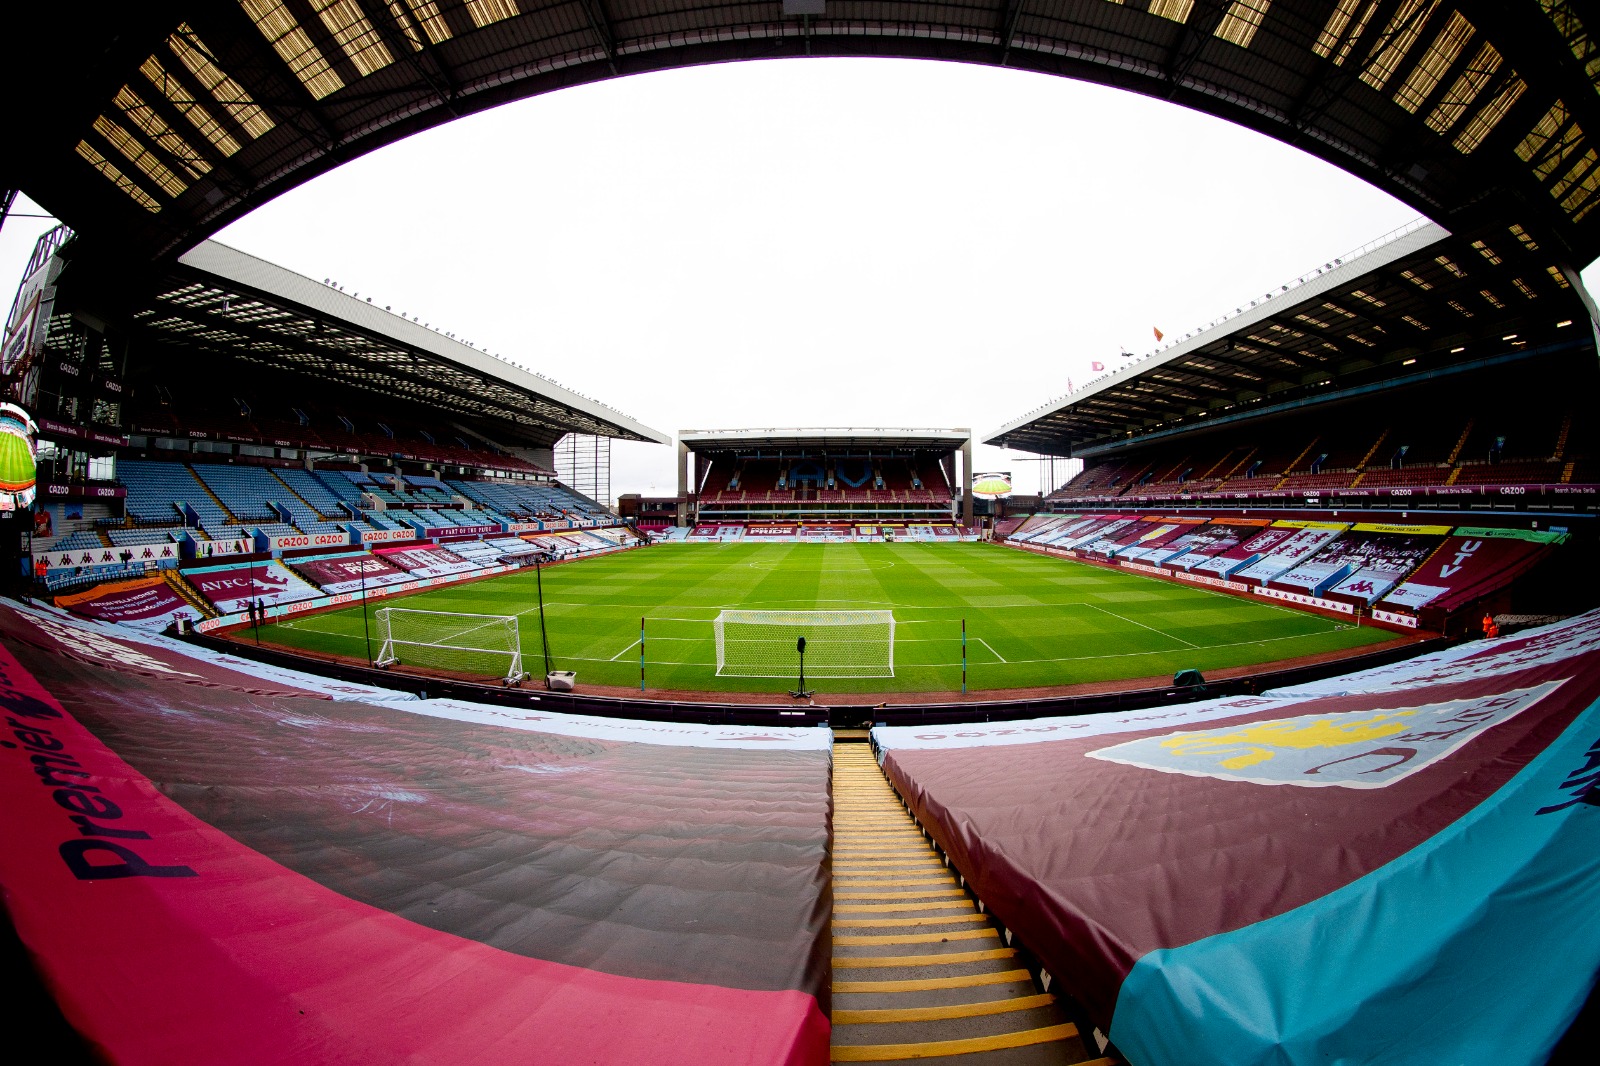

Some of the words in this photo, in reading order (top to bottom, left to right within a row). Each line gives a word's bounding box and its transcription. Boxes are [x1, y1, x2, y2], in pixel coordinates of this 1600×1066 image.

[60, 362, 79, 377] CAZOO
[105, 380, 122, 393] CAZOO
[49, 485, 69, 495] CAZOO
[98, 488, 115, 496] CAZOO
[277, 537, 309, 548] CAZOO
[315, 535, 343, 544] CAZOO
[364, 532, 388, 541] CAZOO
[392, 531, 414, 539] CAZOO
[1439, 540, 1483, 578] UTV
[344, 564, 389, 574] PRIDE
[1285, 573, 1320, 582] CAZOO
[201, 578, 248, 592] AVFC
[400, 582, 419, 591] CAZOO
[1210, 578, 1225, 587] CAZOO
[1228, 582, 1244, 590] CAZOO
[330, 594, 352, 604] CAZOO
[288, 602, 312, 612] CAZOO
[914, 724, 1090, 740] CAZOO
[1, 716, 200, 880] Premier
